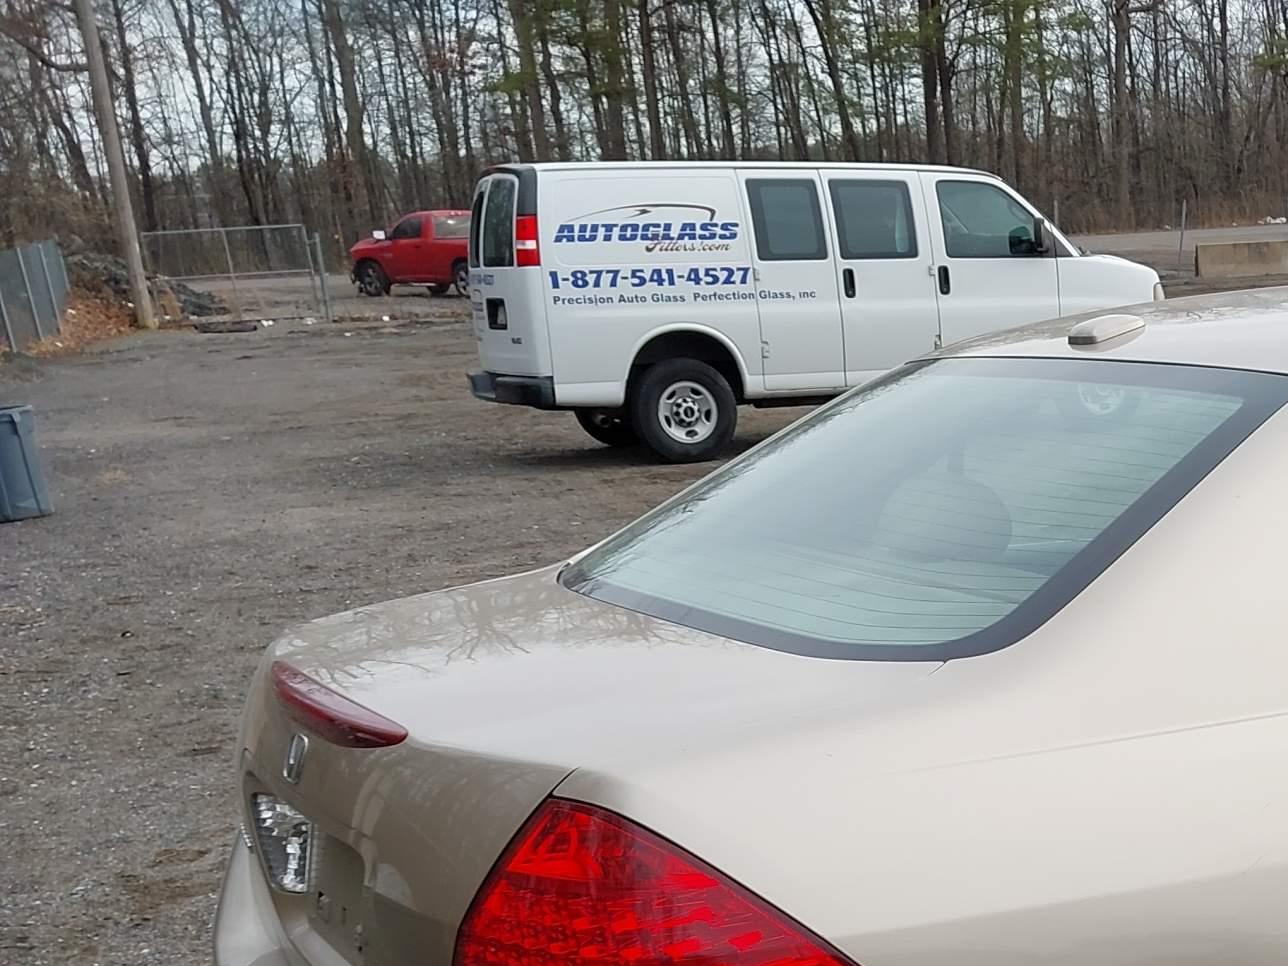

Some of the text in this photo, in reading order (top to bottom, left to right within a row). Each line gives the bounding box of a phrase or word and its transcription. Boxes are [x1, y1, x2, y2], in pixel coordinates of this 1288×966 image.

[553, 222, 739, 242] AUTOGLASS
[549, 267, 751, 289] 1-877-541-4527
[553, 294, 614, 306] Precision
[618, 293, 650, 304] Auto
[651, 292, 686, 304] Glass
[693, 290, 755, 302] Perfection
[758, 289, 796, 301] Glass,
